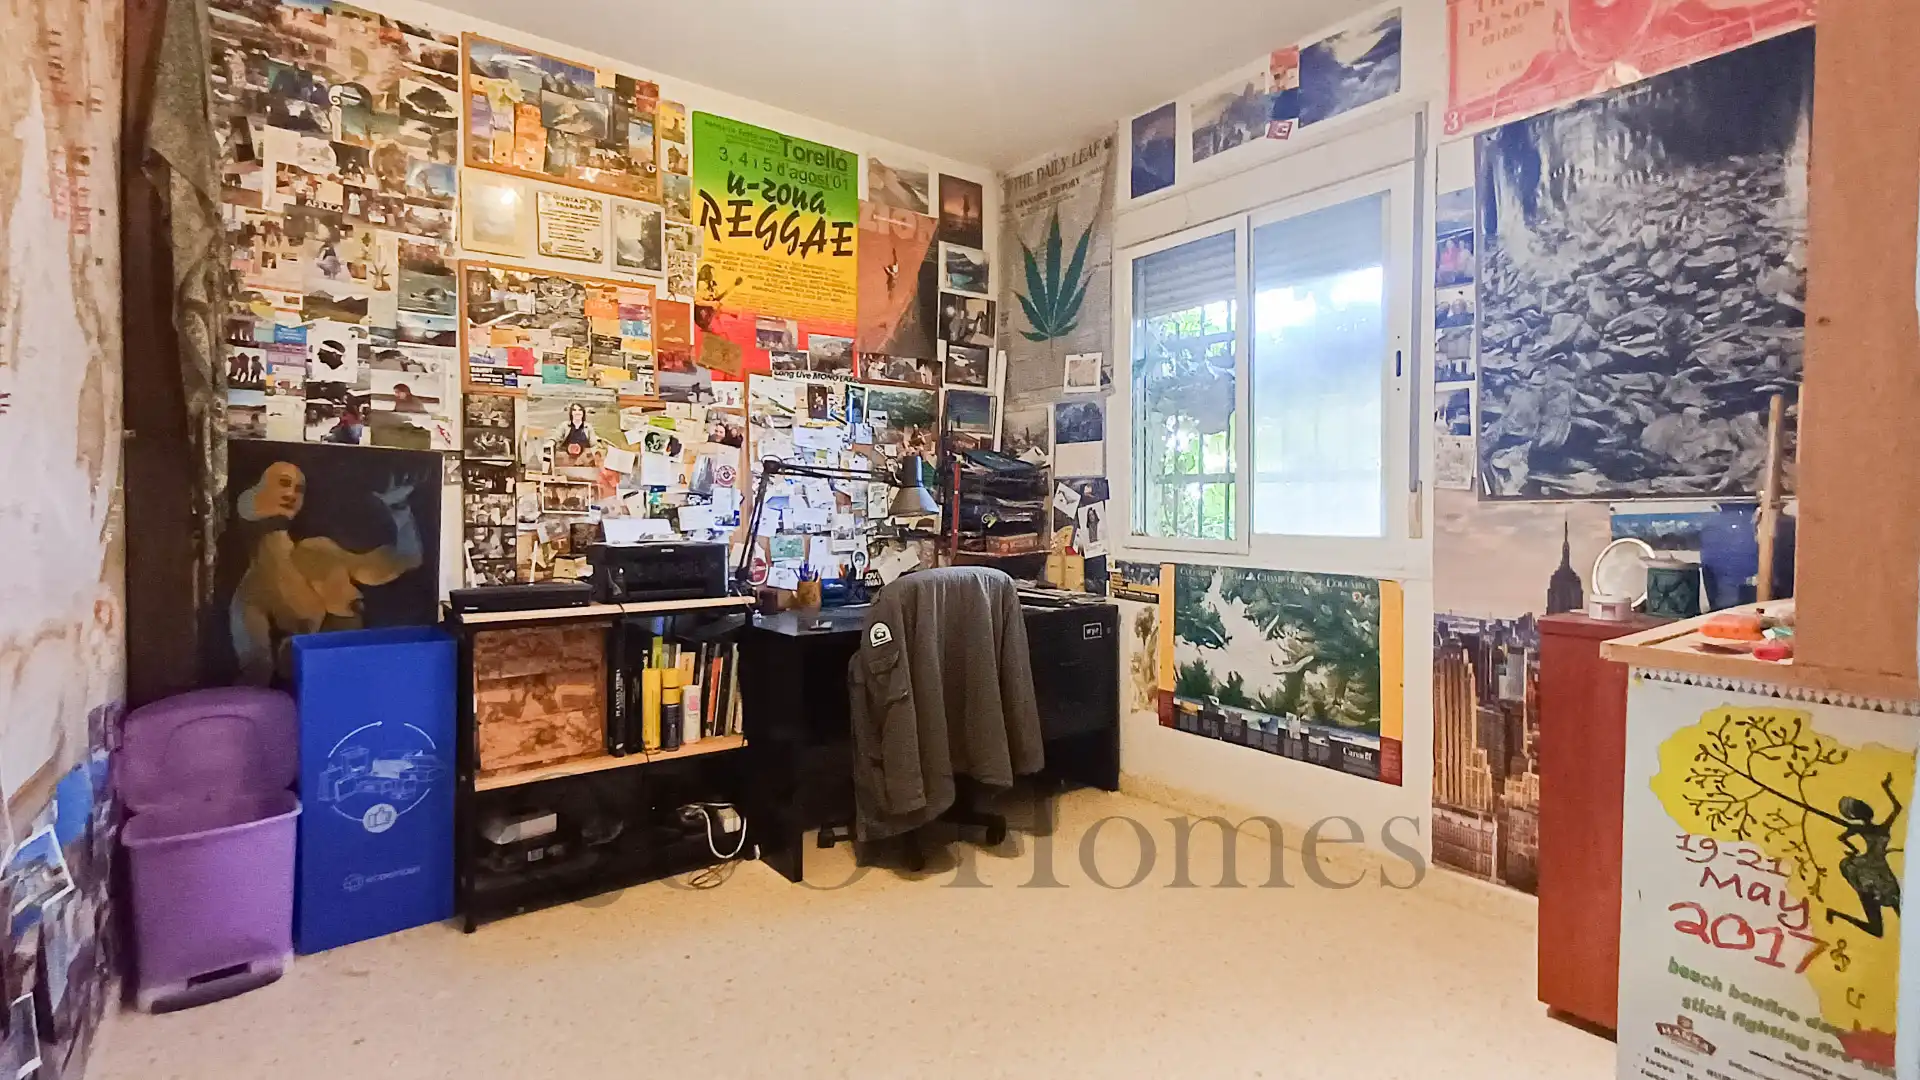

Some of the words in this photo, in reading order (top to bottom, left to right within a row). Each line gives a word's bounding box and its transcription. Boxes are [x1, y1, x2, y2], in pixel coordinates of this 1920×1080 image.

[738, 152, 748, 166] 4
[763, 157, 773, 173] 5
[779, 137, 848, 172] Torelló
[1014, 171, 1034, 192] THE
[1036, 155, 1068, 185] DAILY
[1071, 139, 1102, 168] LEAF
[698, 189, 854, 259] REGGAE
[1676, 835, 1790, 878] 19-21
[1700, 867, 1810, 931] May
[1668, 901, 1830, 974] 2017
[1667, 956, 1723, 993] beach
[1728, 983, 1800, 1022] bonfire
[1681, 996, 1726, 1021] stick
[1732, 1011, 1810, 1051] fighting
